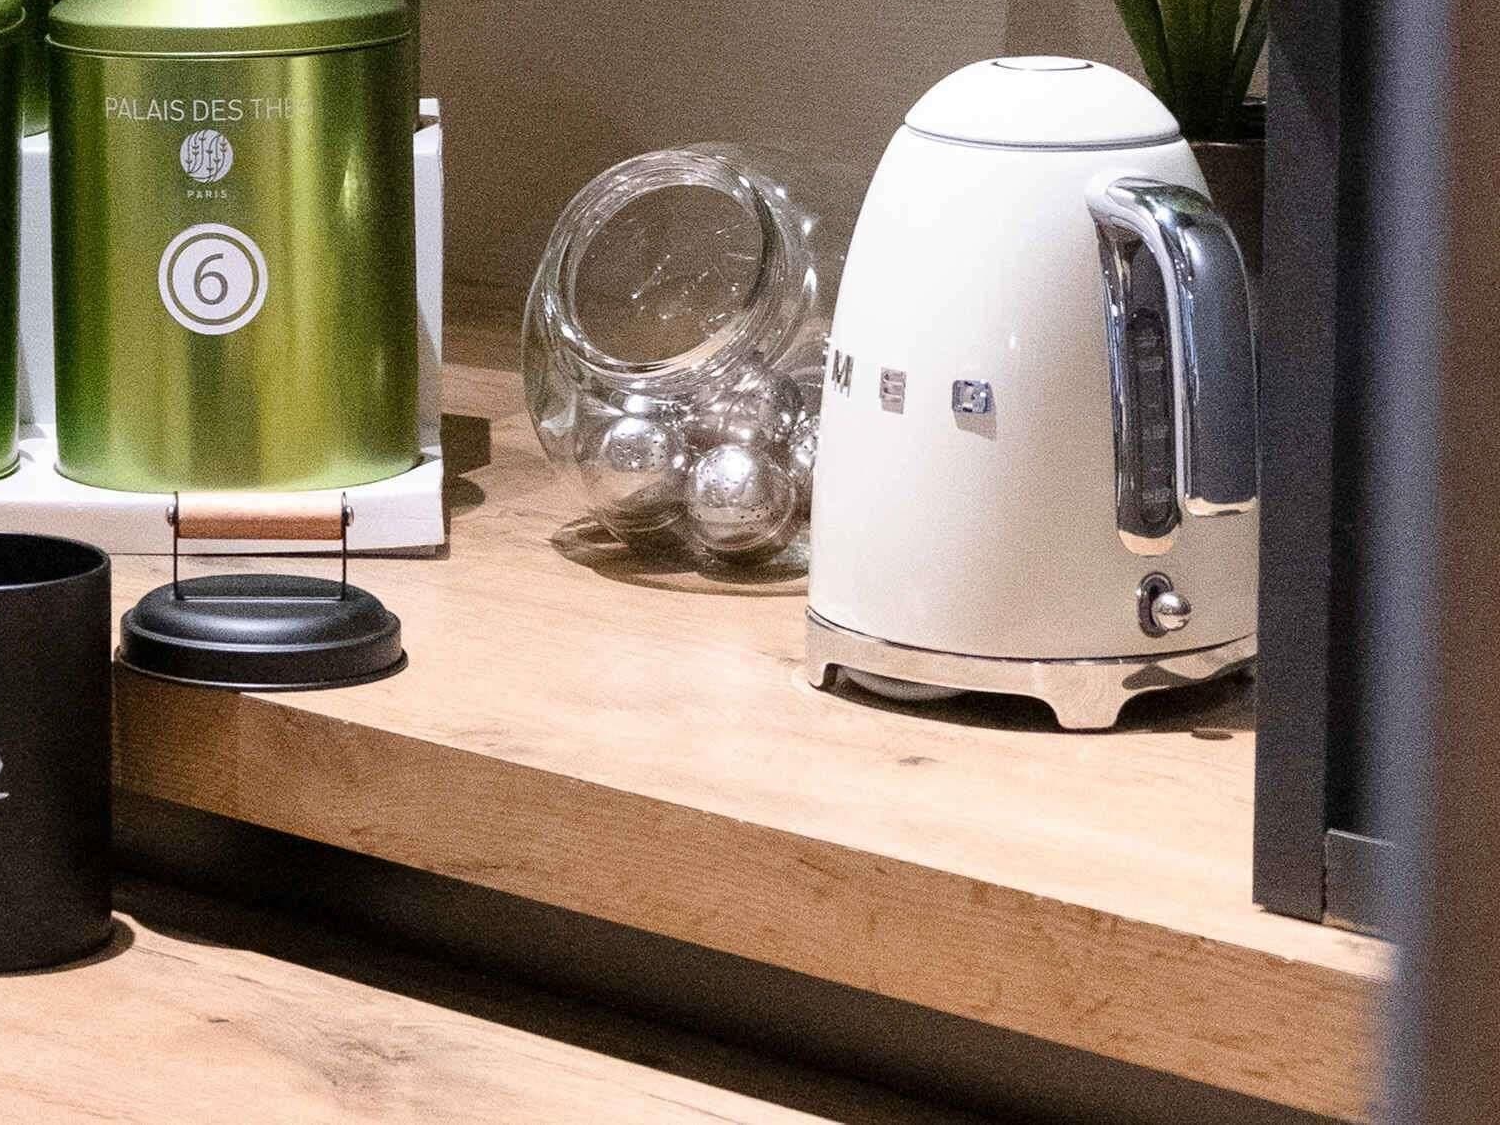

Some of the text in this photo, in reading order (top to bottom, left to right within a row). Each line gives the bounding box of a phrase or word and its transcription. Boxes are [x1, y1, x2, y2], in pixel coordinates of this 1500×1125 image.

[105, 97, 185, 122] PALAIS
[192, 99, 244, 123] DES
[187, 189, 228, 199] PARIS
[193, 253, 228, 306] 6
